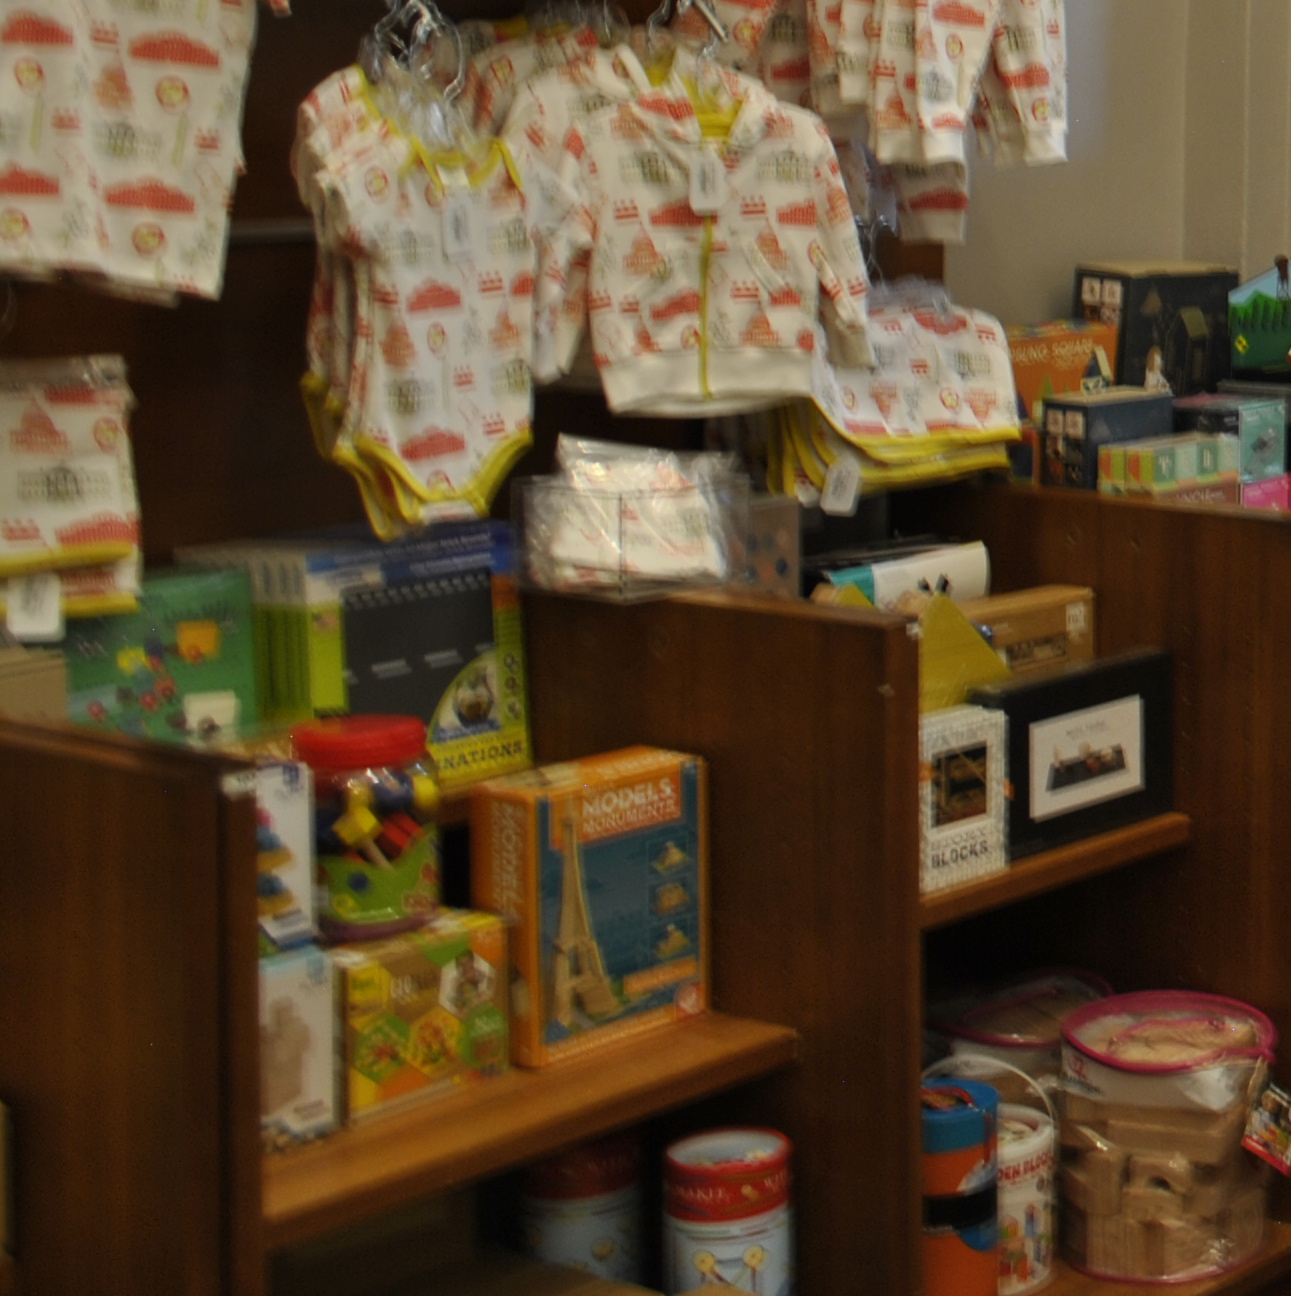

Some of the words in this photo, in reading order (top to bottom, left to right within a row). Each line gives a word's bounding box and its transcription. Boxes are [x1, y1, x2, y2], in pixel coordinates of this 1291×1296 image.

[444, 741, 524, 769] NATIONS
[583, 778, 675, 816] MODELS
[583, 799, 677, 833] MONUMENTS
[932, 840, 988, 868] BLOCKS
